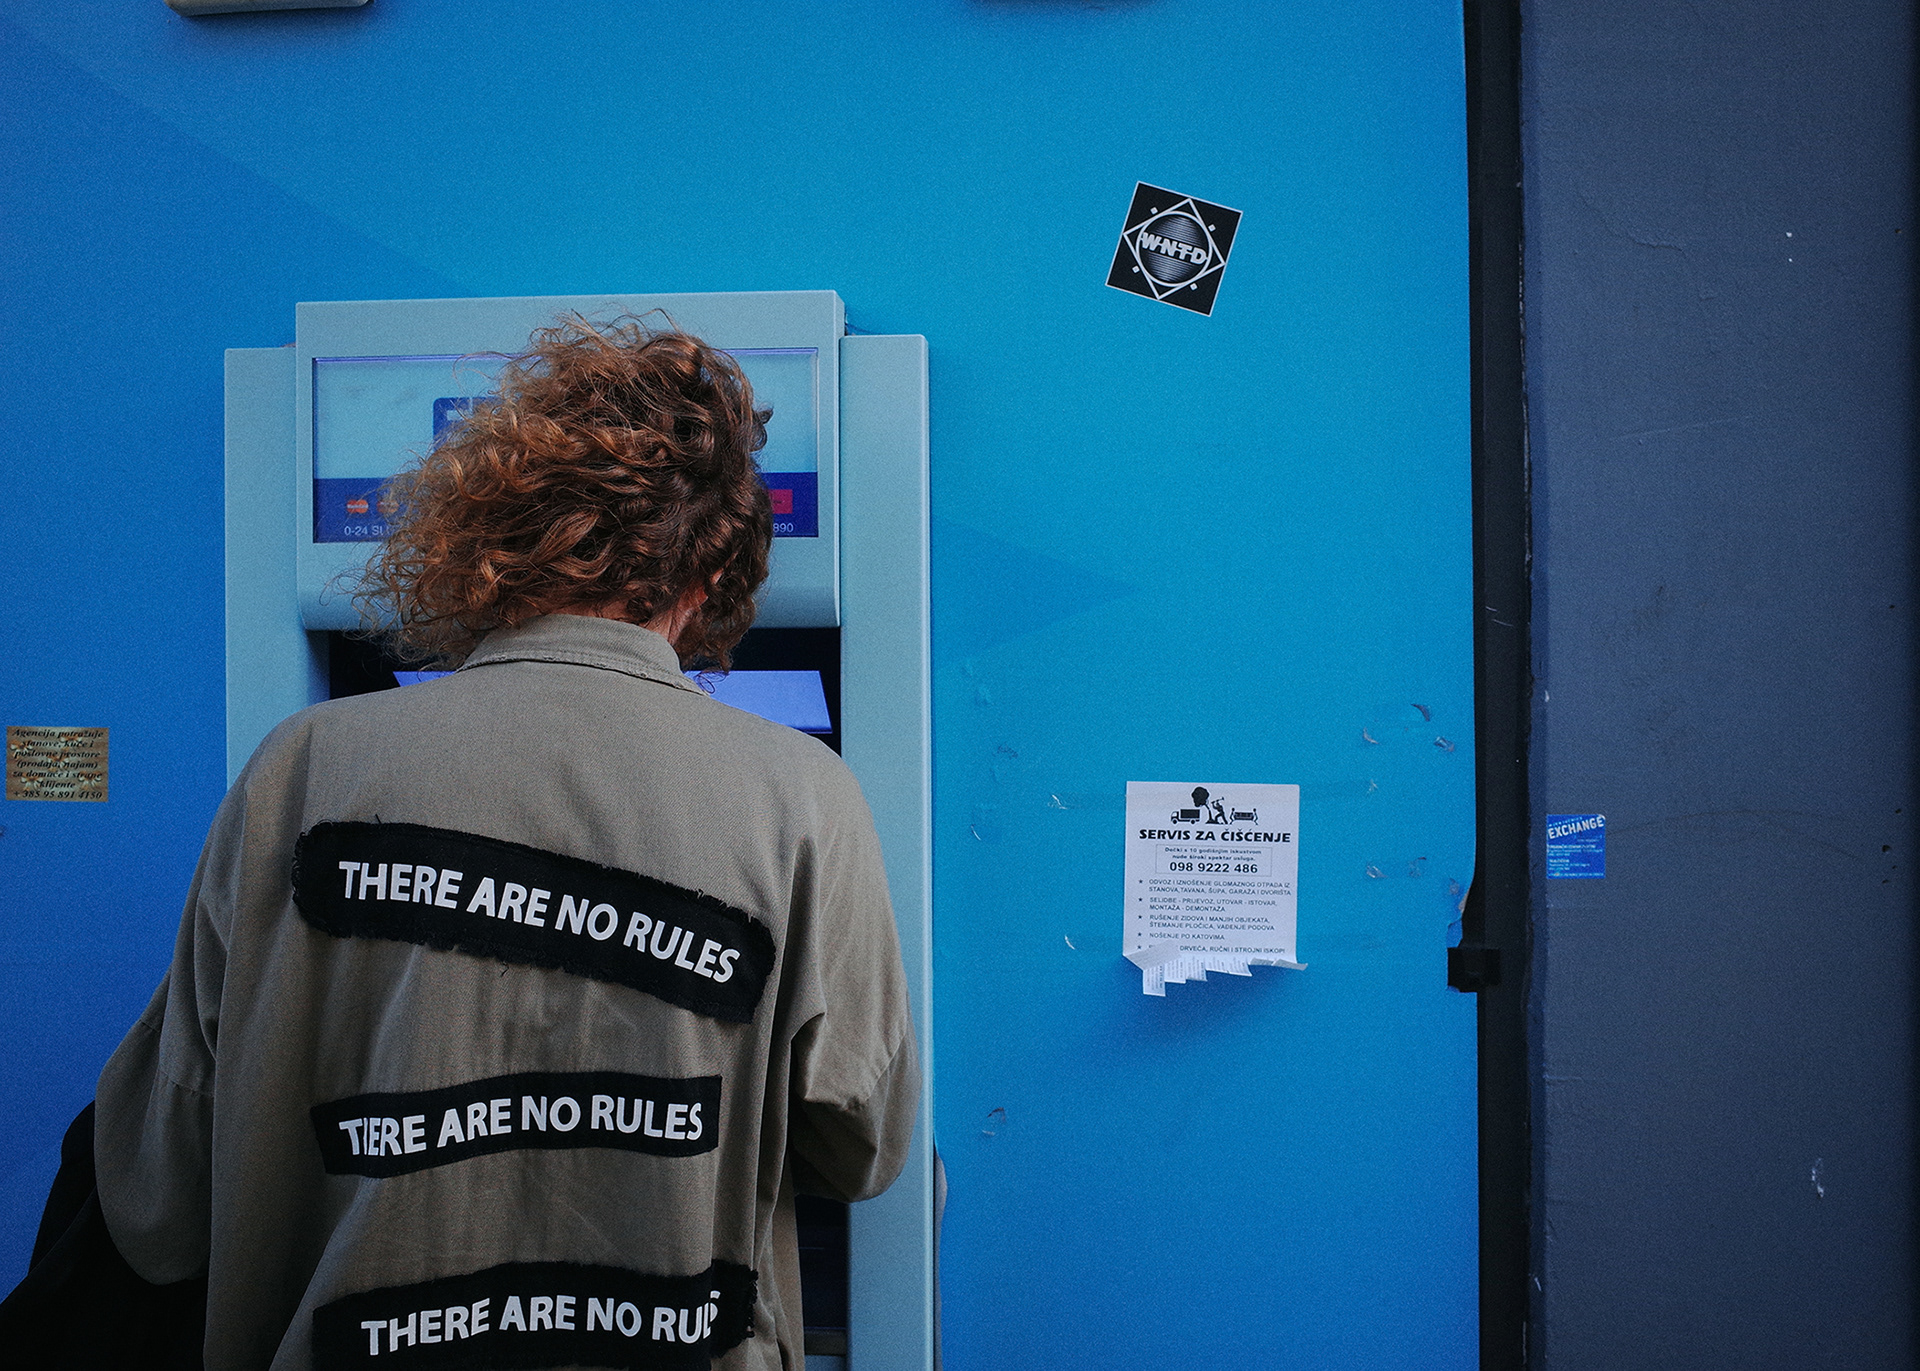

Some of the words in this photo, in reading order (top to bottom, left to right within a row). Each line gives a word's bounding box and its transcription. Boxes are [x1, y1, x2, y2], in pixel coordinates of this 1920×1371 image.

[1140, 231, 1209, 265] WNTD
[344, 525, 368, 536] 0-24
[12, 729, 55, 738] Agencija
[22, 740, 61, 748] stanove,
[90, 740, 94, 748] i
[14, 750, 58, 759] poslovne
[59, 751, 100, 760] prostore
[63, 760, 98, 769] najam)
[72, 771, 103, 779] strane
[40, 780, 76, 789] klijente
[22, 790, 41, 798] 385
[43, 790, 55, 798] 95
[78, 790, 103, 799] 4150
[1547, 816, 1605, 839] EXCHANGE
[1139, 829, 1191, 840] SERVIS
[1195, 830, 1216, 841] ZA
[1220, 828, 1291, 843] ČIŠĆENJE
[1169, 861, 1194, 872] 098
[1197, 862, 1230, 873] 9222
[1234, 863, 1258, 873] 486
[338, 861, 464, 909] THERE
[466, 876, 551, 927] ARE
[554, 894, 618, 941] NO
[623, 911, 741, 983] RULES
[436, 1098, 512, 1148] ARE
[521, 1095, 581, 1132] NO
[590, 1094, 703, 1141] RULES
[361, 1297, 490, 1356] THERE
[499, 1295, 576, 1332] ARE
[586, 1297, 642, 1337] NO
[652, 1290, 721, 1344] RUL
